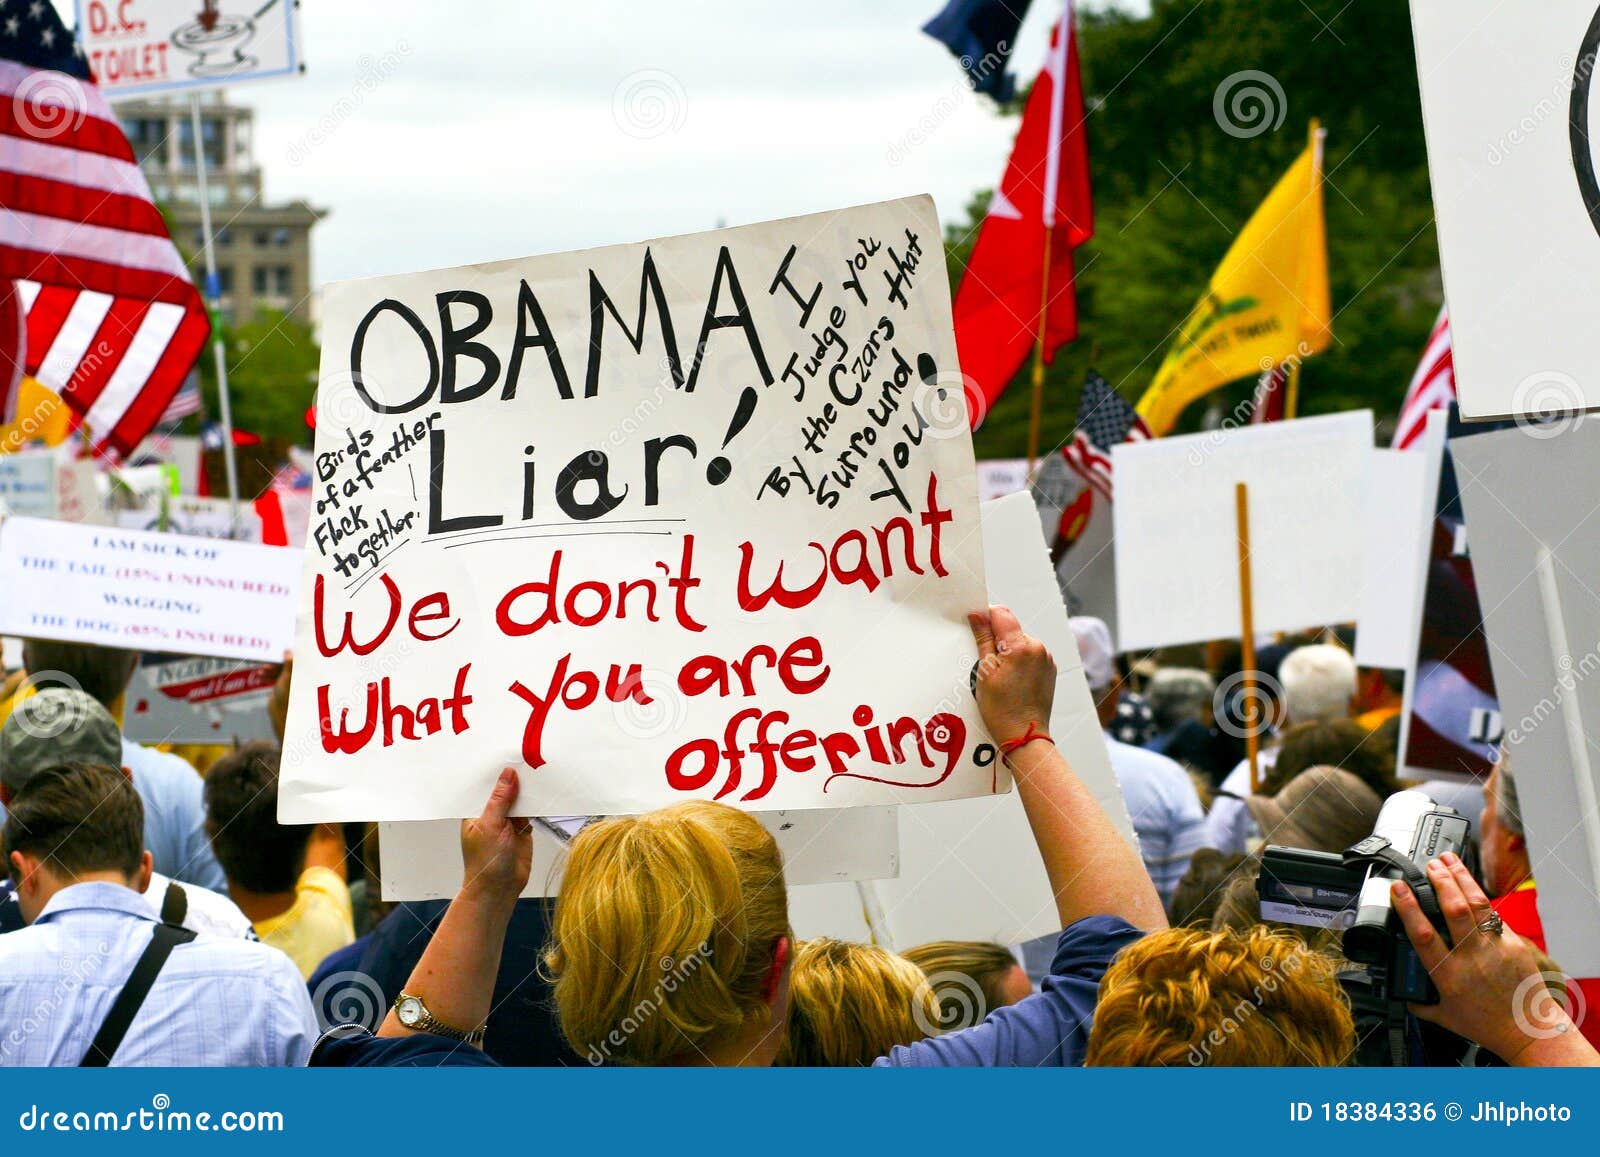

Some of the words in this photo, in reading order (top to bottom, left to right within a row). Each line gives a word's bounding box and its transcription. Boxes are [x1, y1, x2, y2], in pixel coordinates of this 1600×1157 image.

[350, 245, 775, 414] OBAMA
[769, 244, 824, 329] I
[756, 455, 816, 501] By
[801, 402, 838, 454] the
[828, 315, 895, 406] Czars
[883, 228, 923, 310] that
[780, 305, 849, 403] Judge
[316, 427, 374, 482] Birds
[316, 483, 341, 515] of
[343, 478, 360, 497] a
[355, 411, 442, 490] feather
[428, 386, 758, 535] Liar!
[314, 572, 461, 657] We
[495, 534, 708, 637] don't
[677, 636, 831, 696] are
